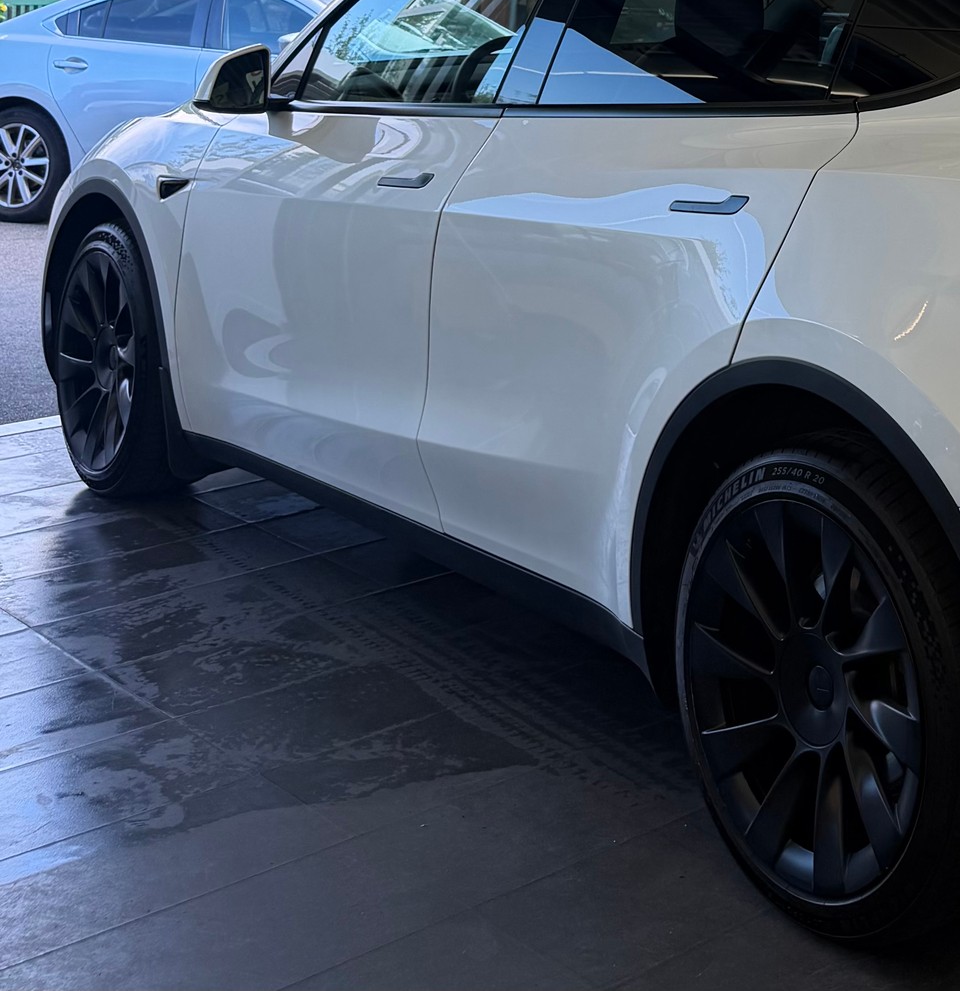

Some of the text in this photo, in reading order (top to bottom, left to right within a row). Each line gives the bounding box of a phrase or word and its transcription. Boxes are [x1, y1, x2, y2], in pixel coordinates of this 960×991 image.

[703, 467, 826, 527] MICHELIN 255/40 R 20
